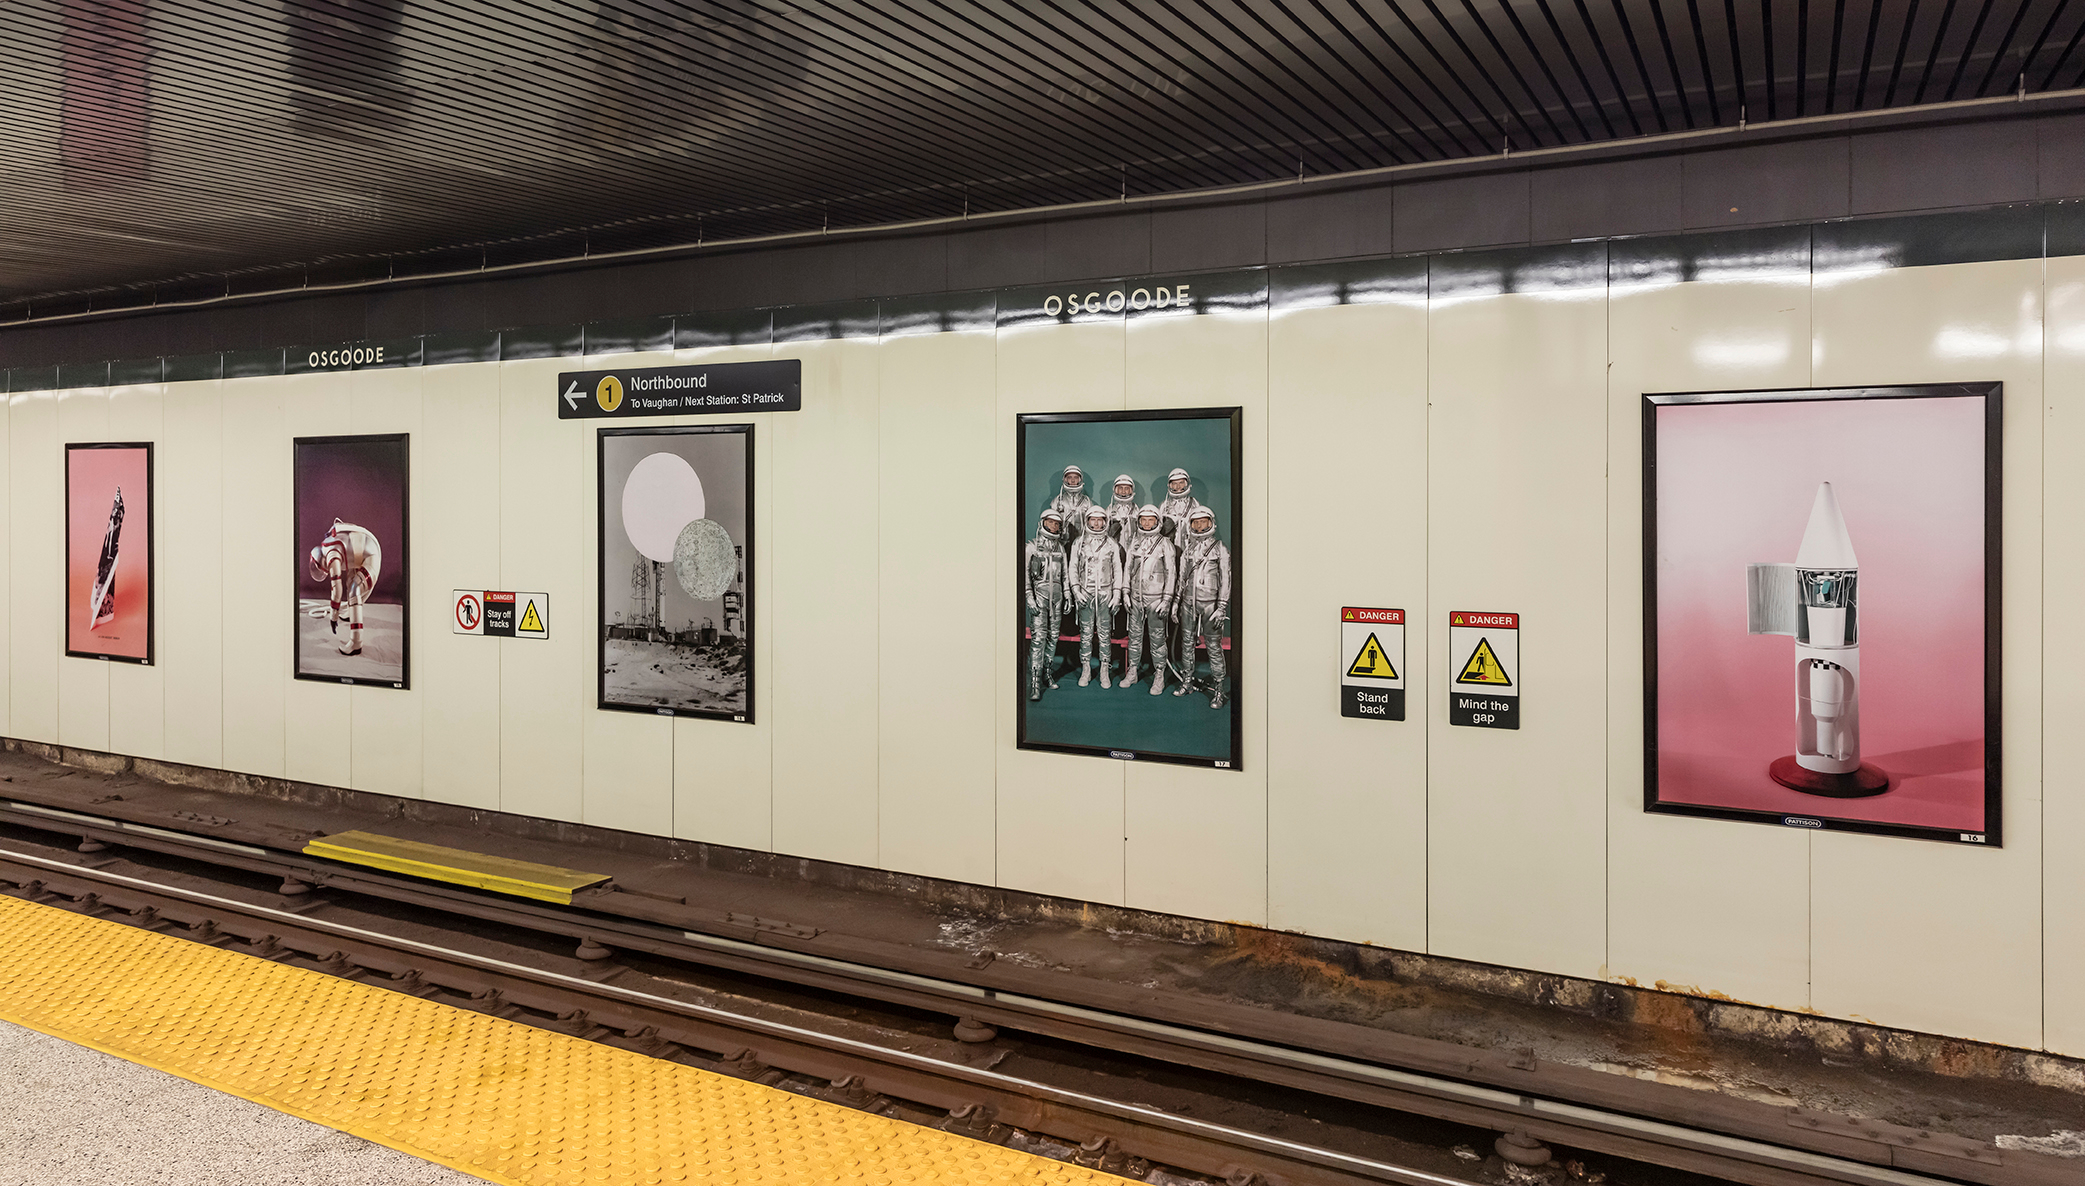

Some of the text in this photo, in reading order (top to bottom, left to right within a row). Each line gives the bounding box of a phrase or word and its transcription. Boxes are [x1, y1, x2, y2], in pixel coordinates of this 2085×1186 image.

[1043, 284, 1190, 316] OSGOODE
[308, 346, 384, 368] OSGOODE
[630, 373, 707, 391] Northbound
[604, 384, 613, 403] 1
[630, 392, 784, 410] To Vaughan / Next Station: St Patrick
[487, 609, 512, 620] Stay off
[1359, 611, 1400, 621] DANGER
[1469, 615, 1513, 625] DANGER
[489, 620, 510, 629] tracks
[1357, 691, 1389, 703] Stand
[1359, 703, 1386, 715] back
[1459, 698, 1510, 712] Mind the
[1472, 713, 1496, 724] gap
[1968, 834, 1979, 842] 16
